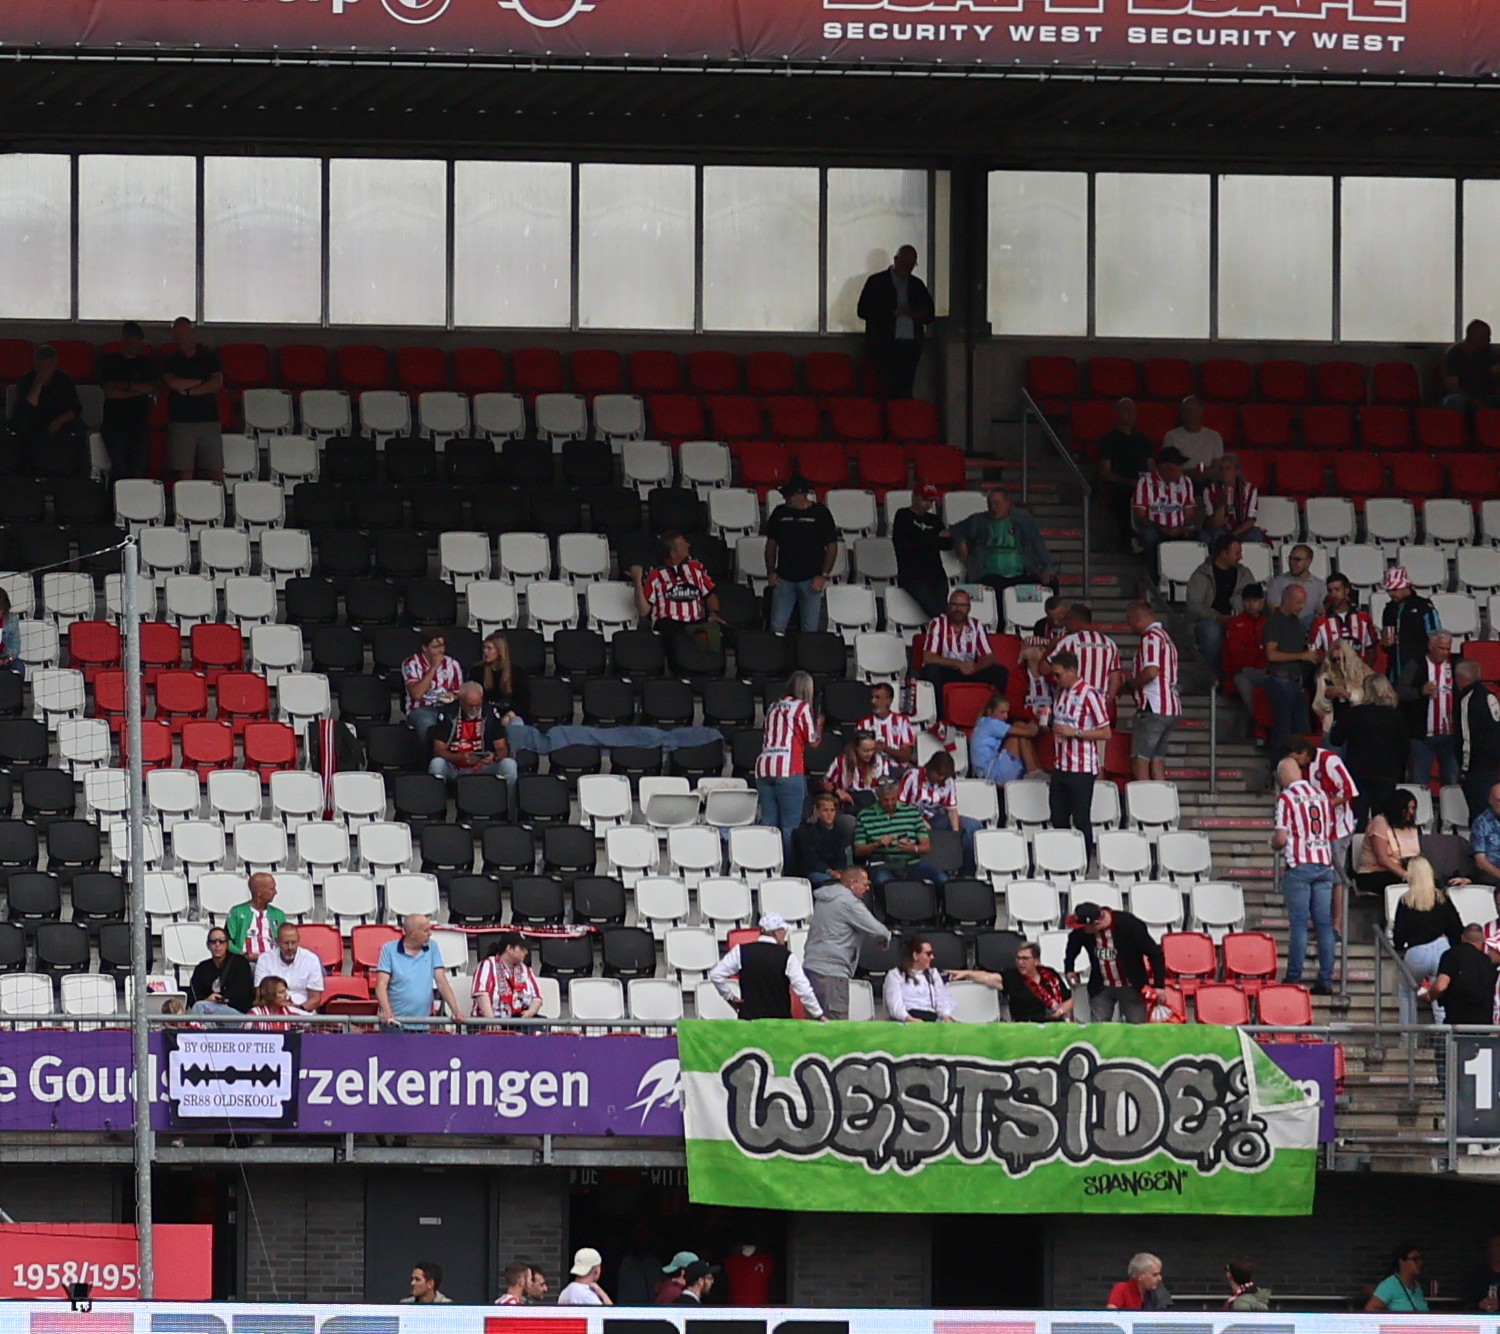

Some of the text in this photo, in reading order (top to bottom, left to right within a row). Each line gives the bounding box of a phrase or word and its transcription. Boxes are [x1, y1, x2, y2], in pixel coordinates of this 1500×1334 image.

[823, 22, 1103, 43] SECURITY WEST
[1127, 27, 1405, 52] SECURITY WEST
[184, 1042, 275, 1053] BY ORDER OF THE
[299, 1057, 589, 1117] zekeringen
[213, 1094, 277, 1107] OLDSKOOL
